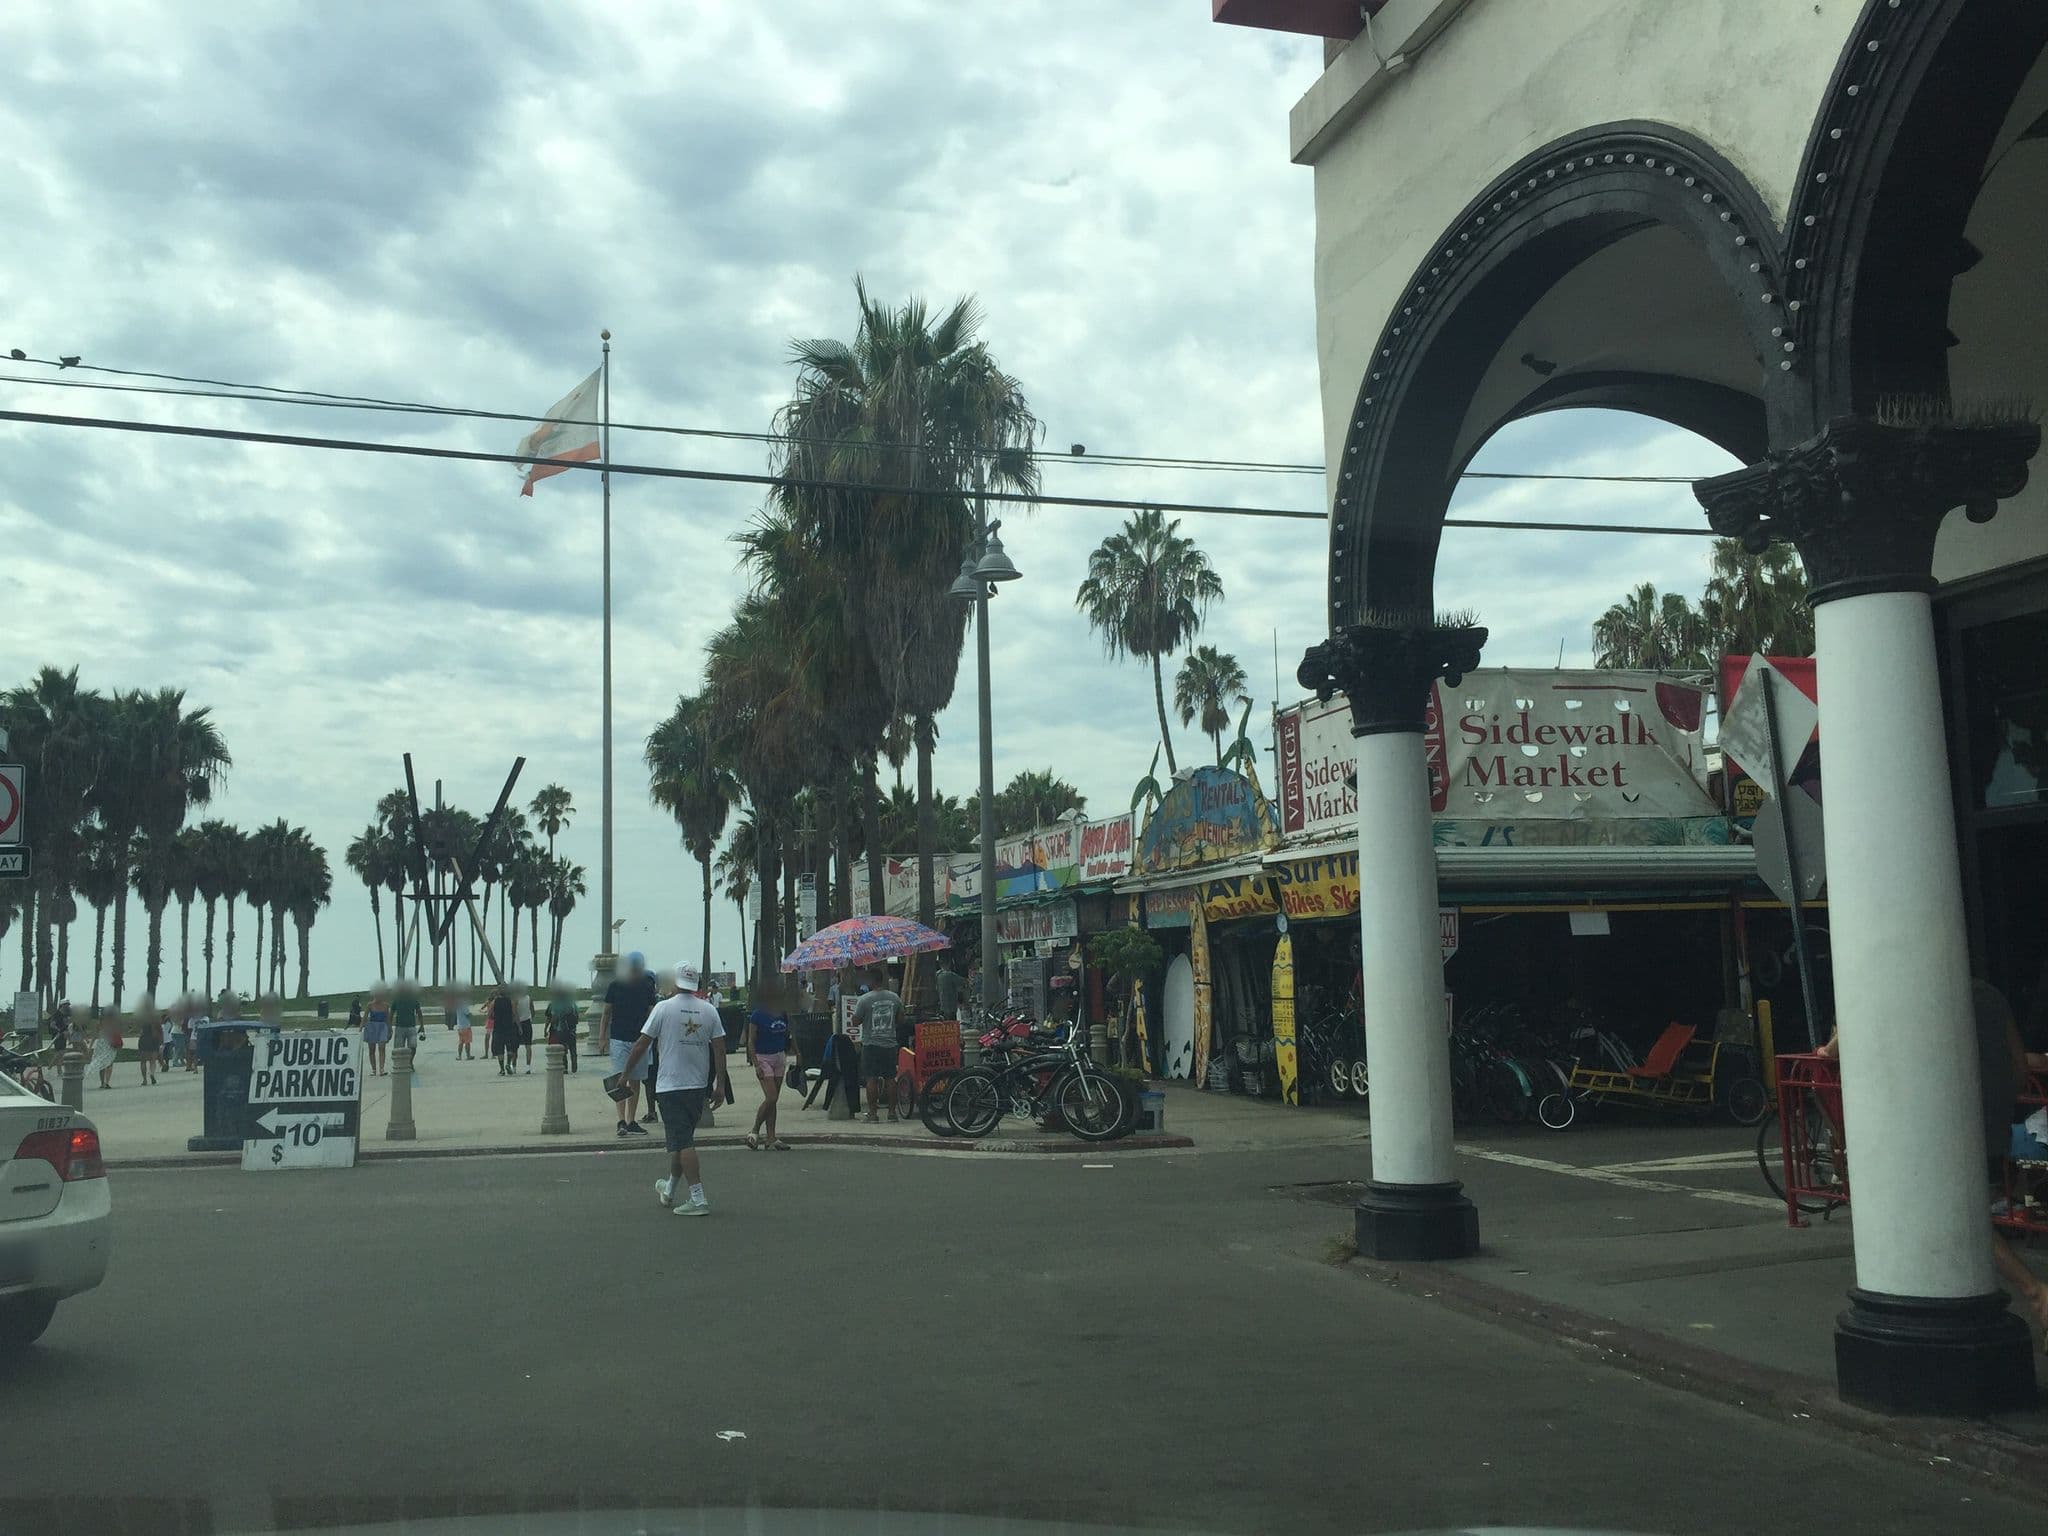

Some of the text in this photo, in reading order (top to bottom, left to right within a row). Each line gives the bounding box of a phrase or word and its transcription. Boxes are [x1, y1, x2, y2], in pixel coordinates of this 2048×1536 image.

[1459, 712, 1660, 746] Sidewalk
[1285, 722, 1300, 821] VENICE
[1305, 757, 1357, 790] Sidew
[1464, 754, 1628, 787] Market
[0, 856, 18, 869] AY
[1283, 890, 1325, 915] Bikes
[1330, 885, 1362, 911] Ska
[267, 1037, 348, 1067] PUBLIC
[254, 1068, 355, 1098] PARKING
[287, 1123, 322, 1147] 10
